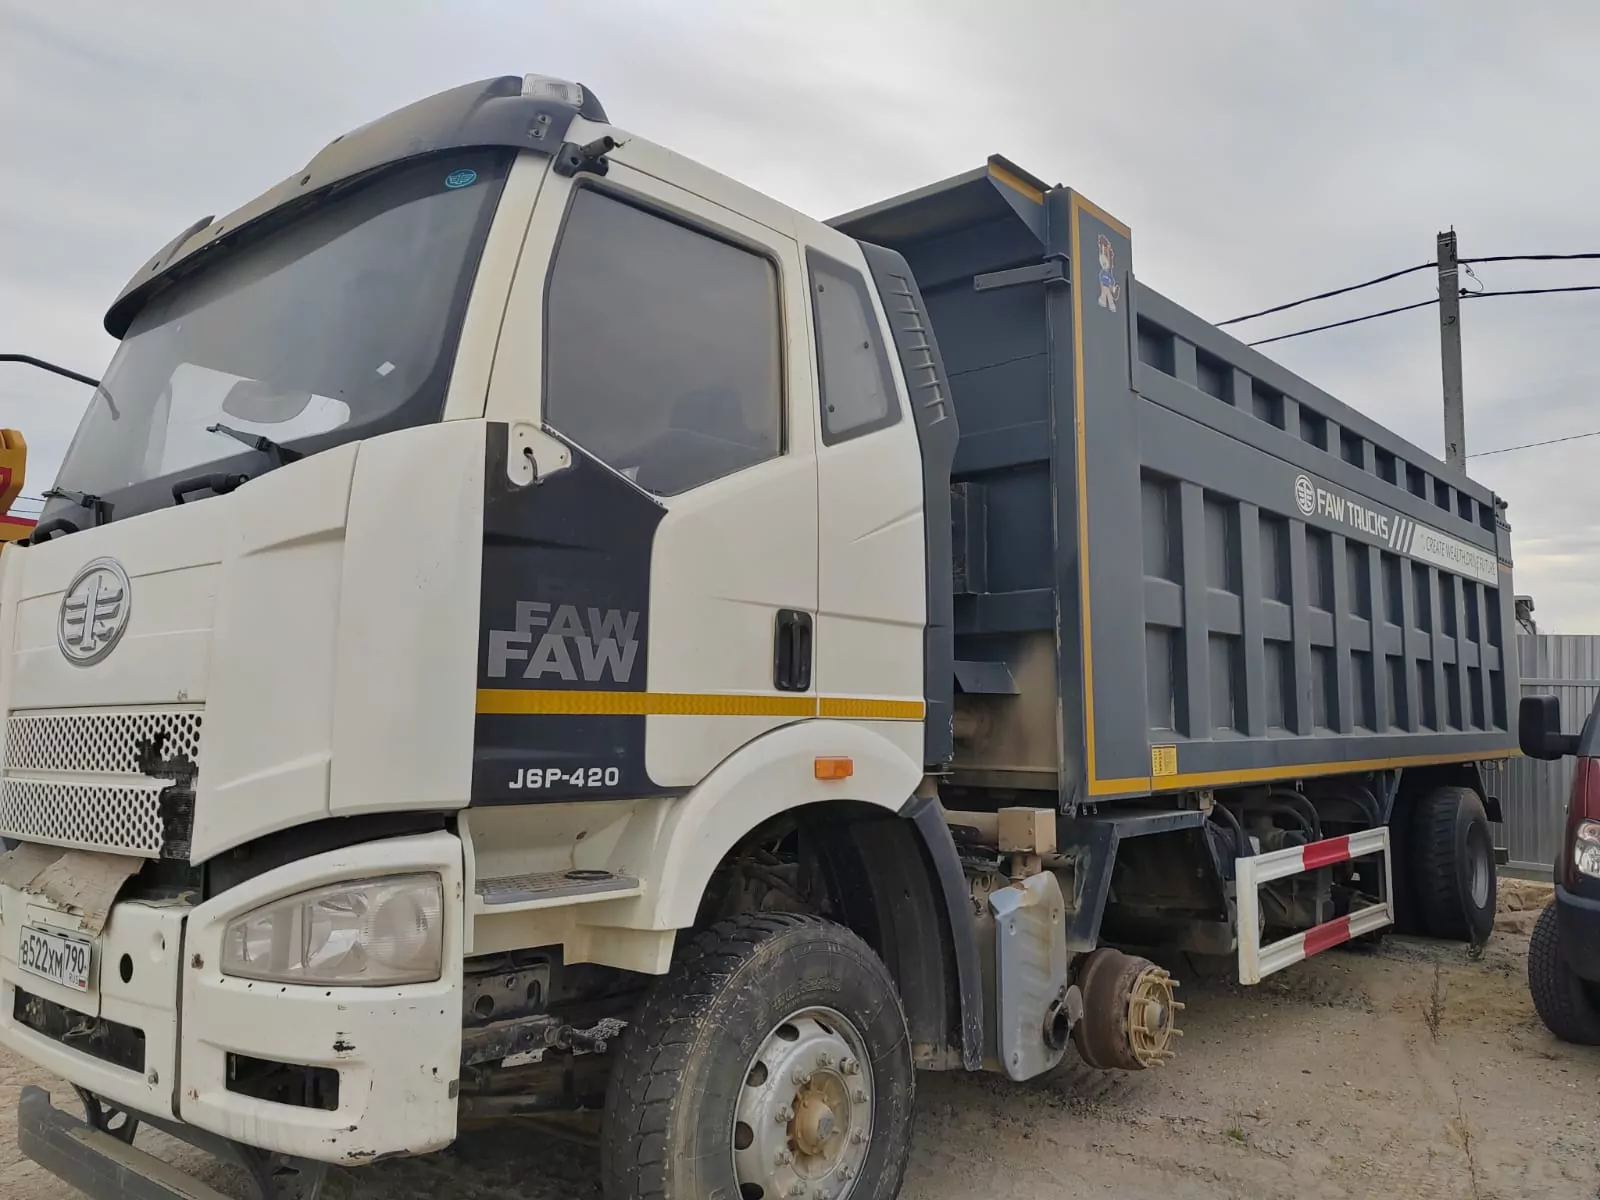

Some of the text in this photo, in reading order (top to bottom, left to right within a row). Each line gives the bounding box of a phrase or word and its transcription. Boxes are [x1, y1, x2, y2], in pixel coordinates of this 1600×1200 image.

[1317, 488, 1389, 540] FAW TRUCKS
[515, 600, 640, 648] FAW
[487, 629, 639, 682] FAW
[509, 767, 620, 789] J6P-420
[65, 943, 84, 974] 790
